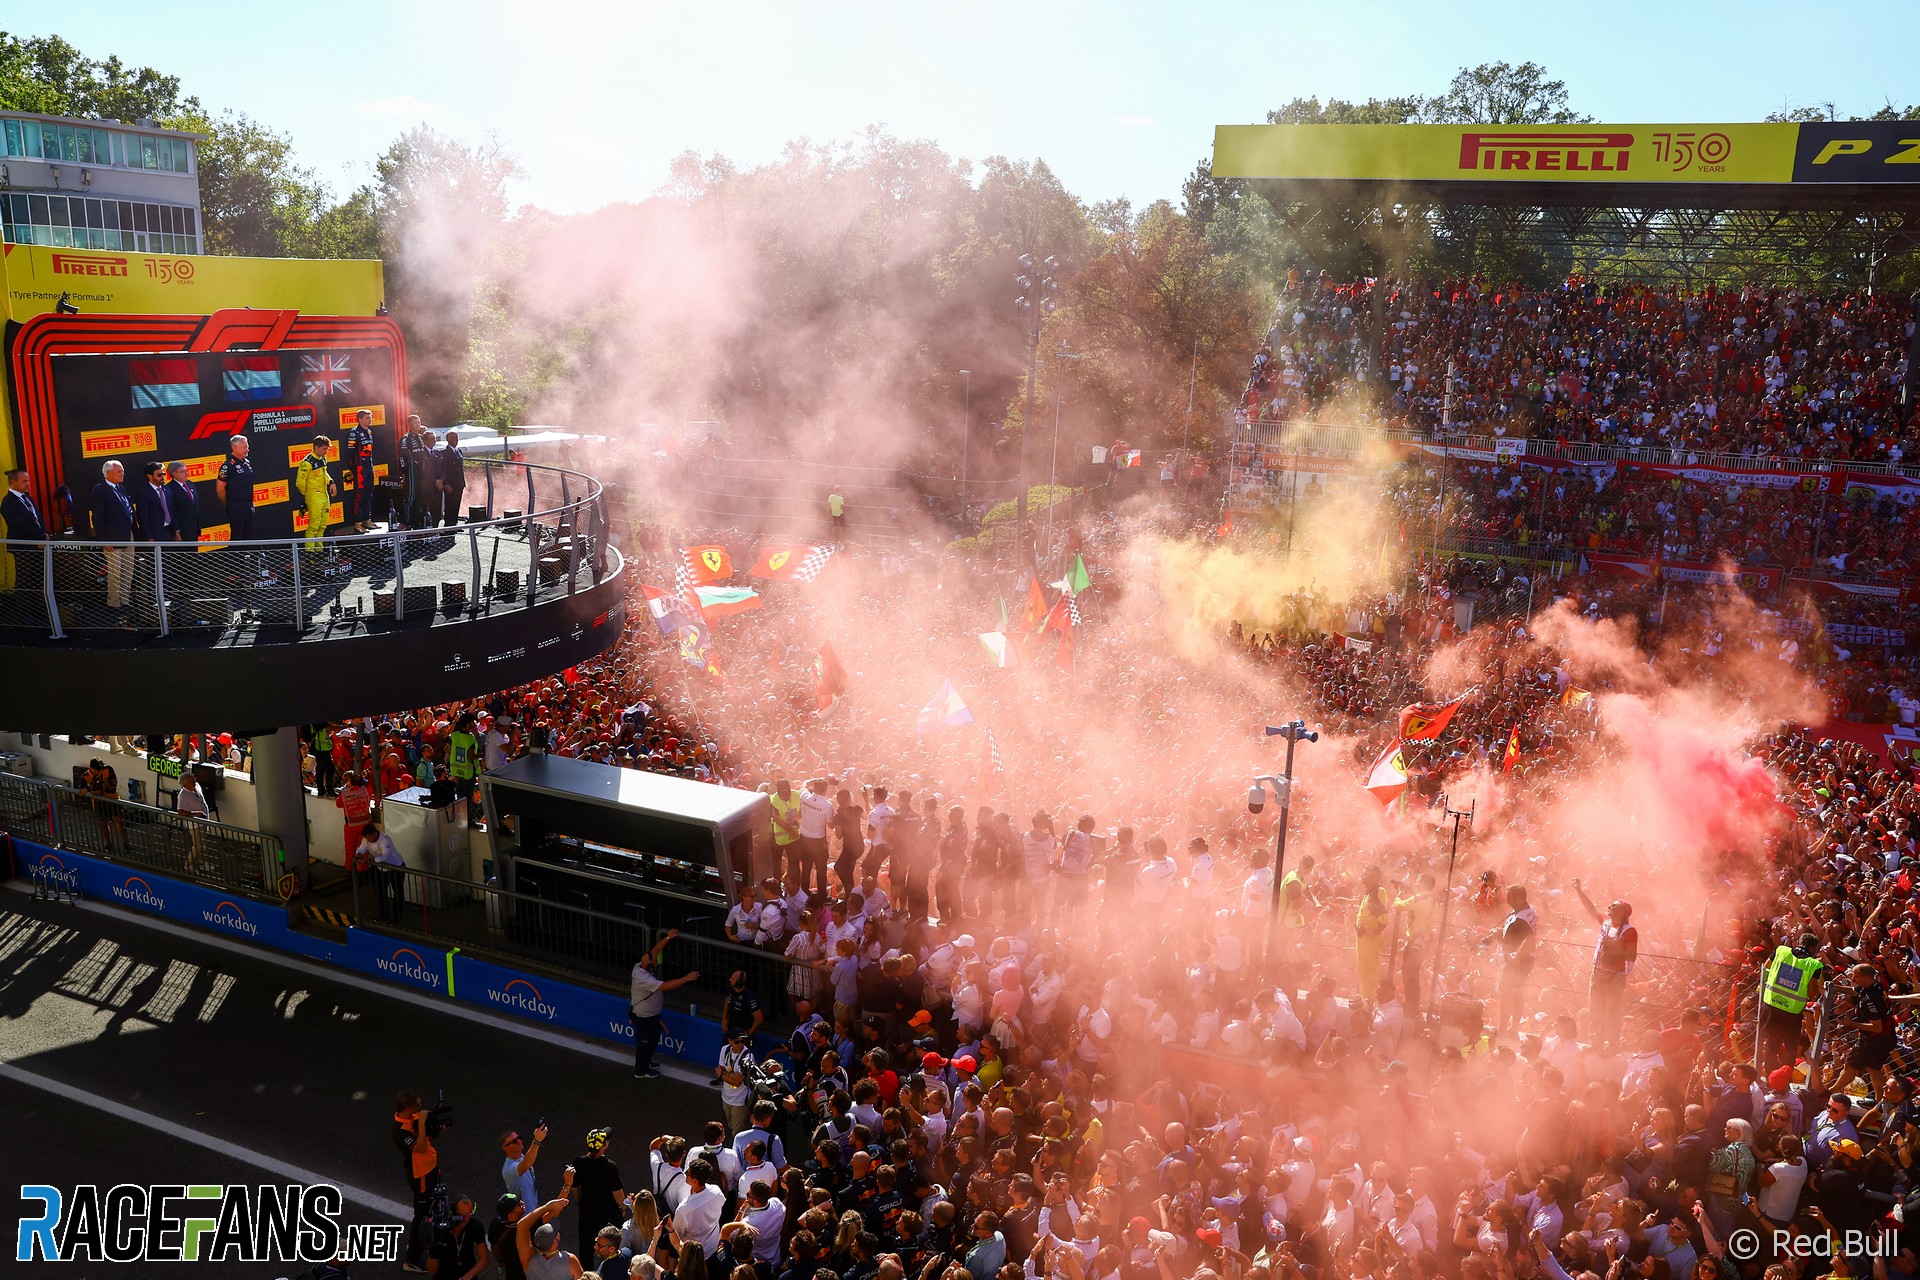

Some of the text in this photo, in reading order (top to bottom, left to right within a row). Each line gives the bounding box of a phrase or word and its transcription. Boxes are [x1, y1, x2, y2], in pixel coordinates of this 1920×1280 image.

[1458, 132, 1732, 172] PIRELLI 150
[1812, 139, 1873, 165] P
[1697, 165, 1726, 173] YEARS
[52, 253, 195, 284] PIRELLI 150
[13, 291, 33, 300] Tyre
[73, 293, 105, 301] Formula
[253, 411, 281, 420] FORMULA
[85, 434, 130, 451] PIRELLI
[1268, 459, 1293, 467] JULES
[149, 755, 183, 777] GEORGE
[879, 1198, 902, 1211] ORACLE
